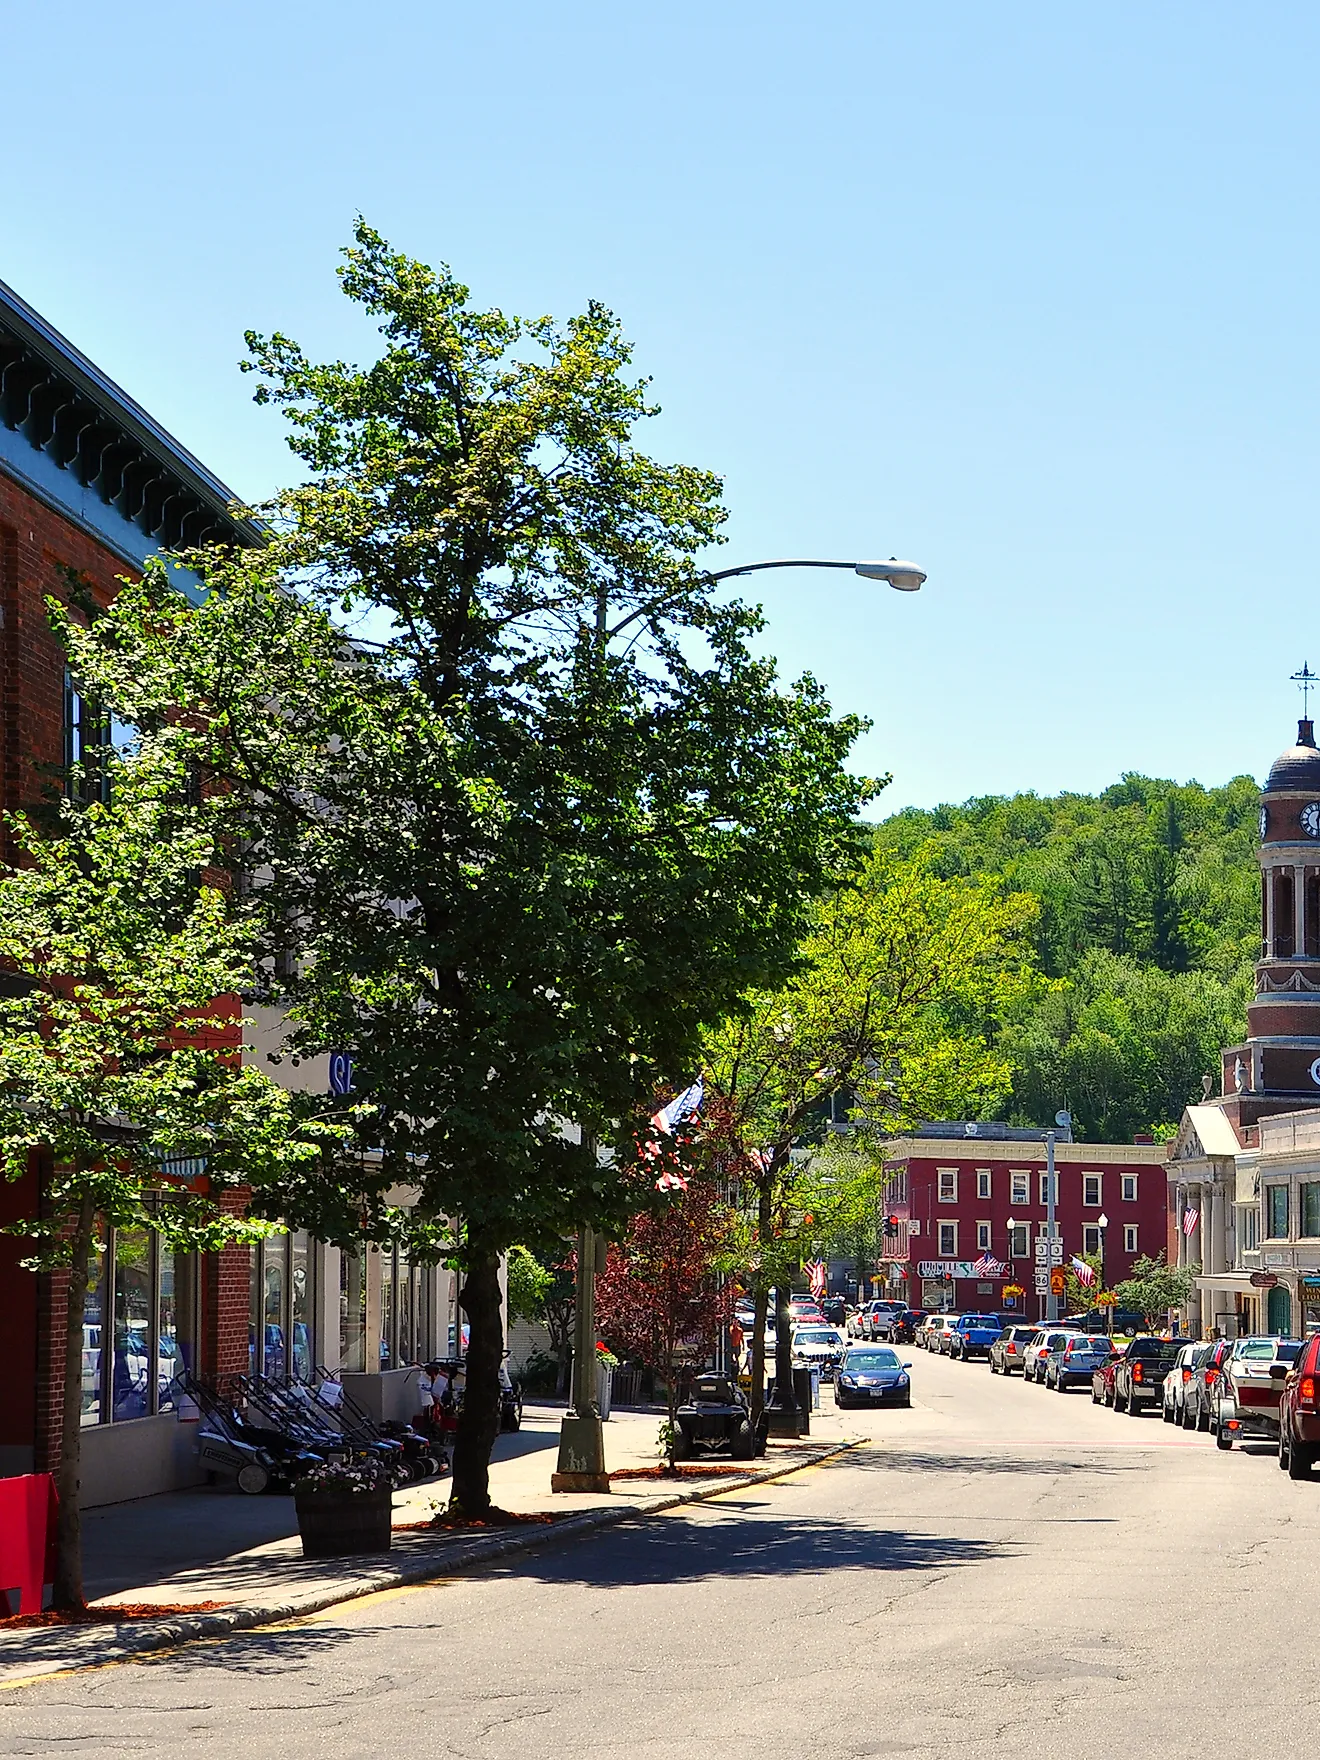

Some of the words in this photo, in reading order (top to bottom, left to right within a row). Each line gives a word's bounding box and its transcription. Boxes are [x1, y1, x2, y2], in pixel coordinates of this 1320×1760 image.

[1039, 1246, 1044, 1254] 3
[1054, 1246, 1060, 1254] 3
[1036, 1276, 1047, 1284] 86
